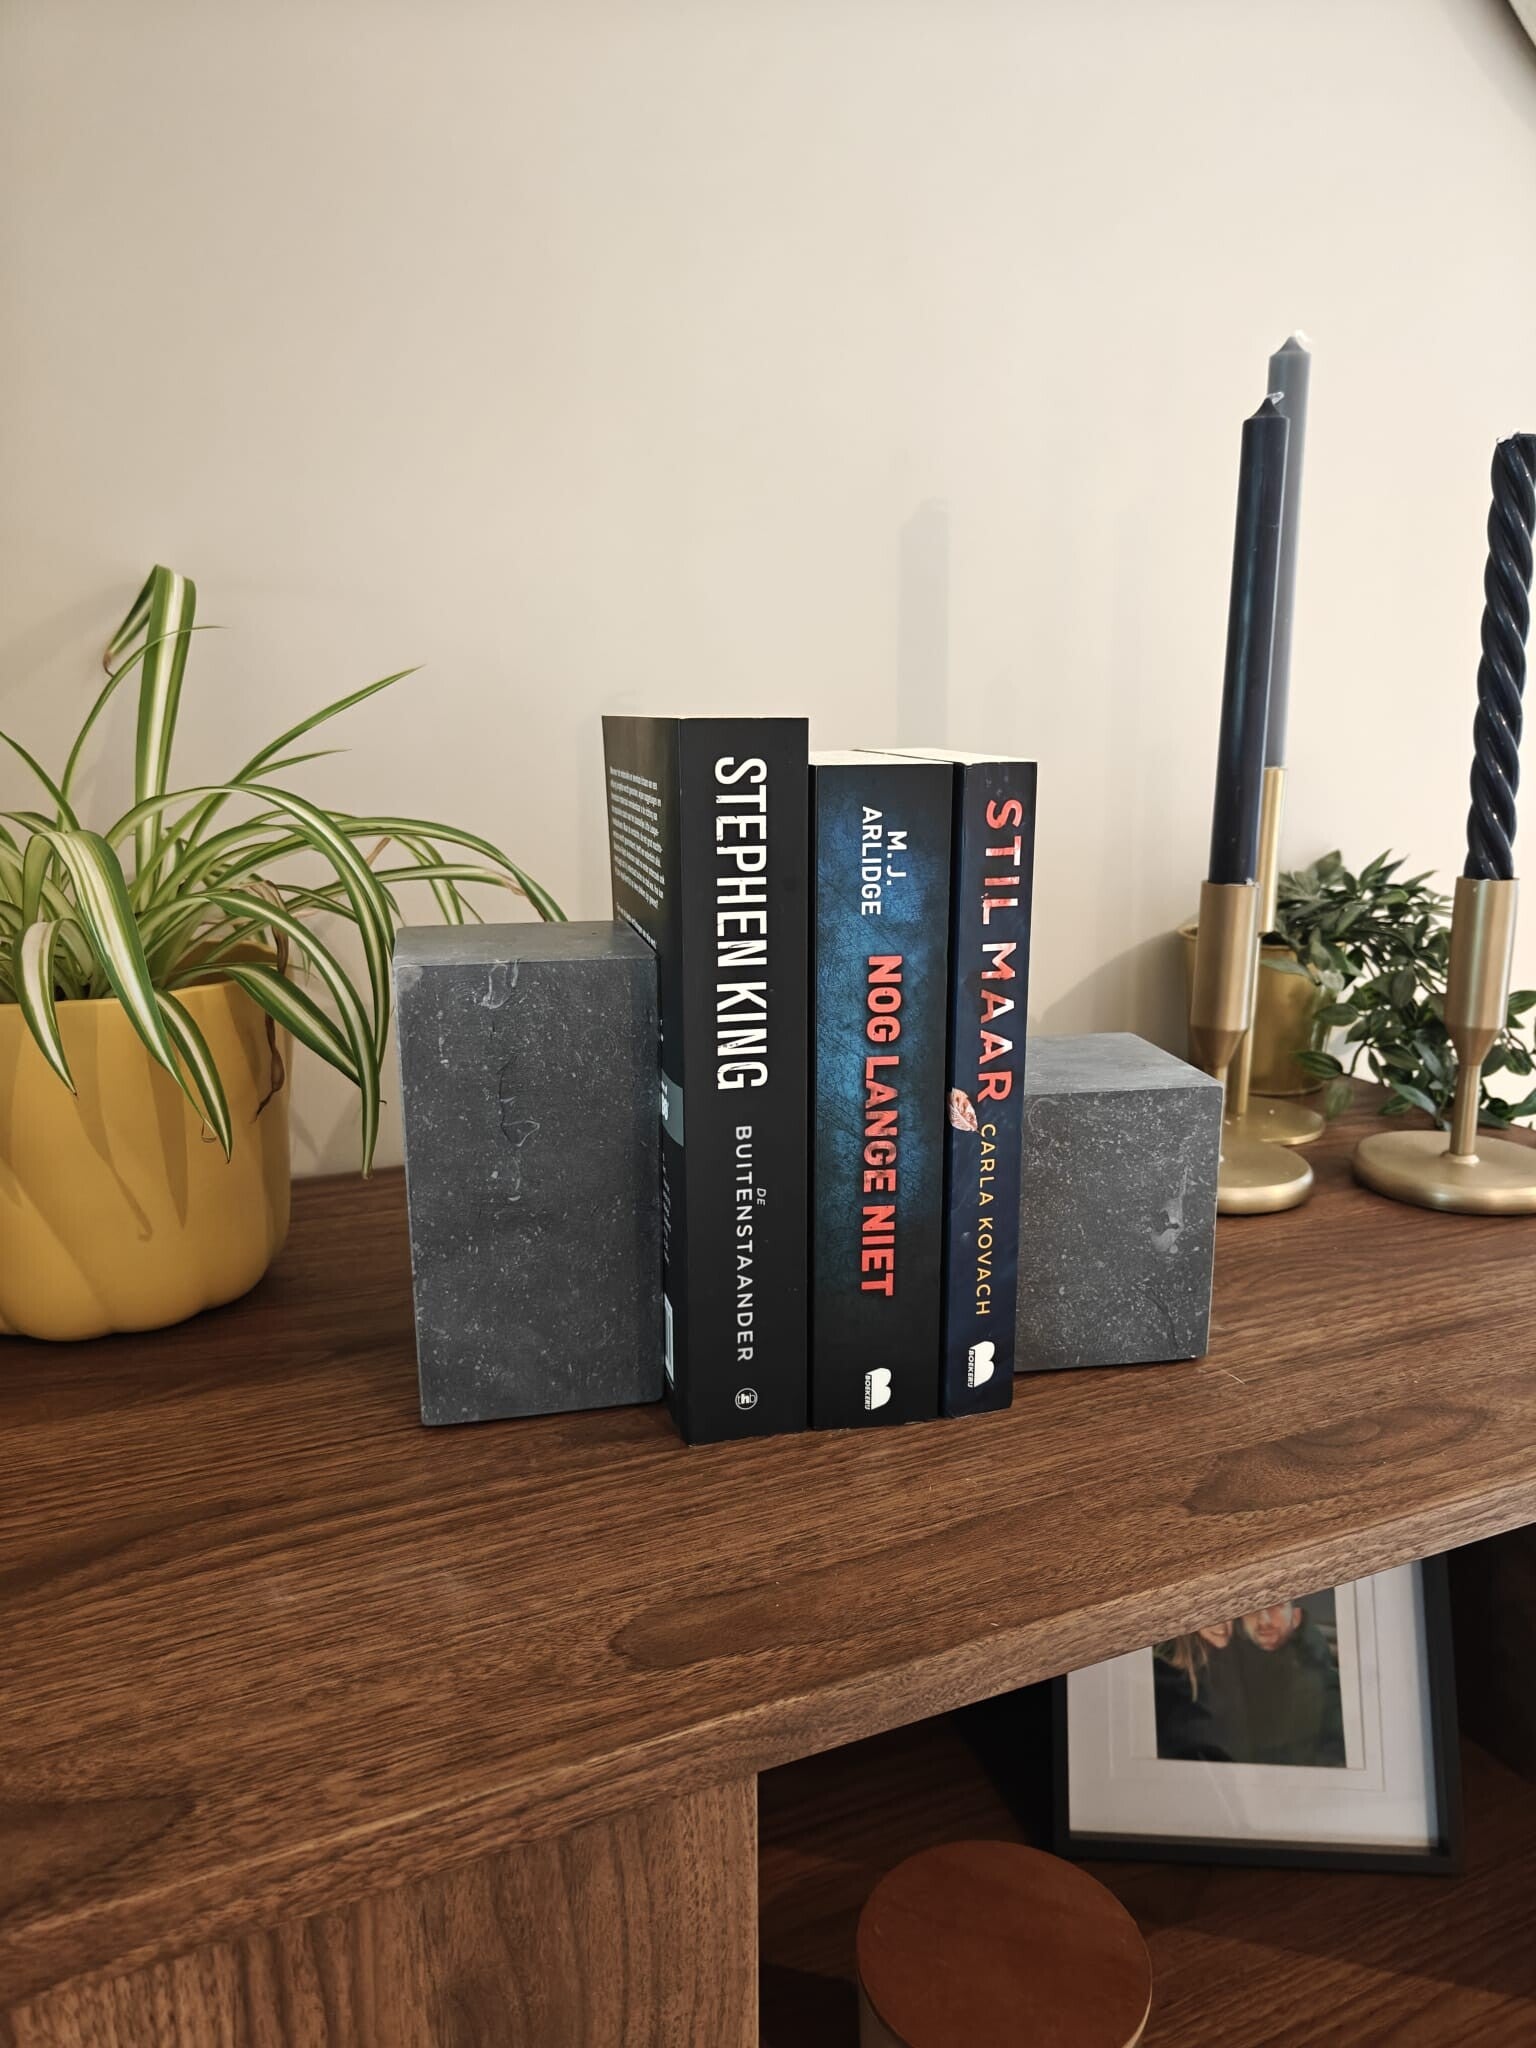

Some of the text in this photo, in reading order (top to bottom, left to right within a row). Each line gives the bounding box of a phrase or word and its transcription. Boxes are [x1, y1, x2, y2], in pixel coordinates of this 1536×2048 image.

[714, 756, 769, 1090] STEPHEN KING
[861, 806, 883, 916] ARLIDGE
[977, 799, 1023, 1102] STIL MAAR
[735, 1125, 754, 1362] BUITENSTAANDER
[756, 1187, 767, 1206] DE
[861, 955, 903, 1296] NOG LANGE NIET
[975, 1123, 997, 1315] CARLA KOVACH
